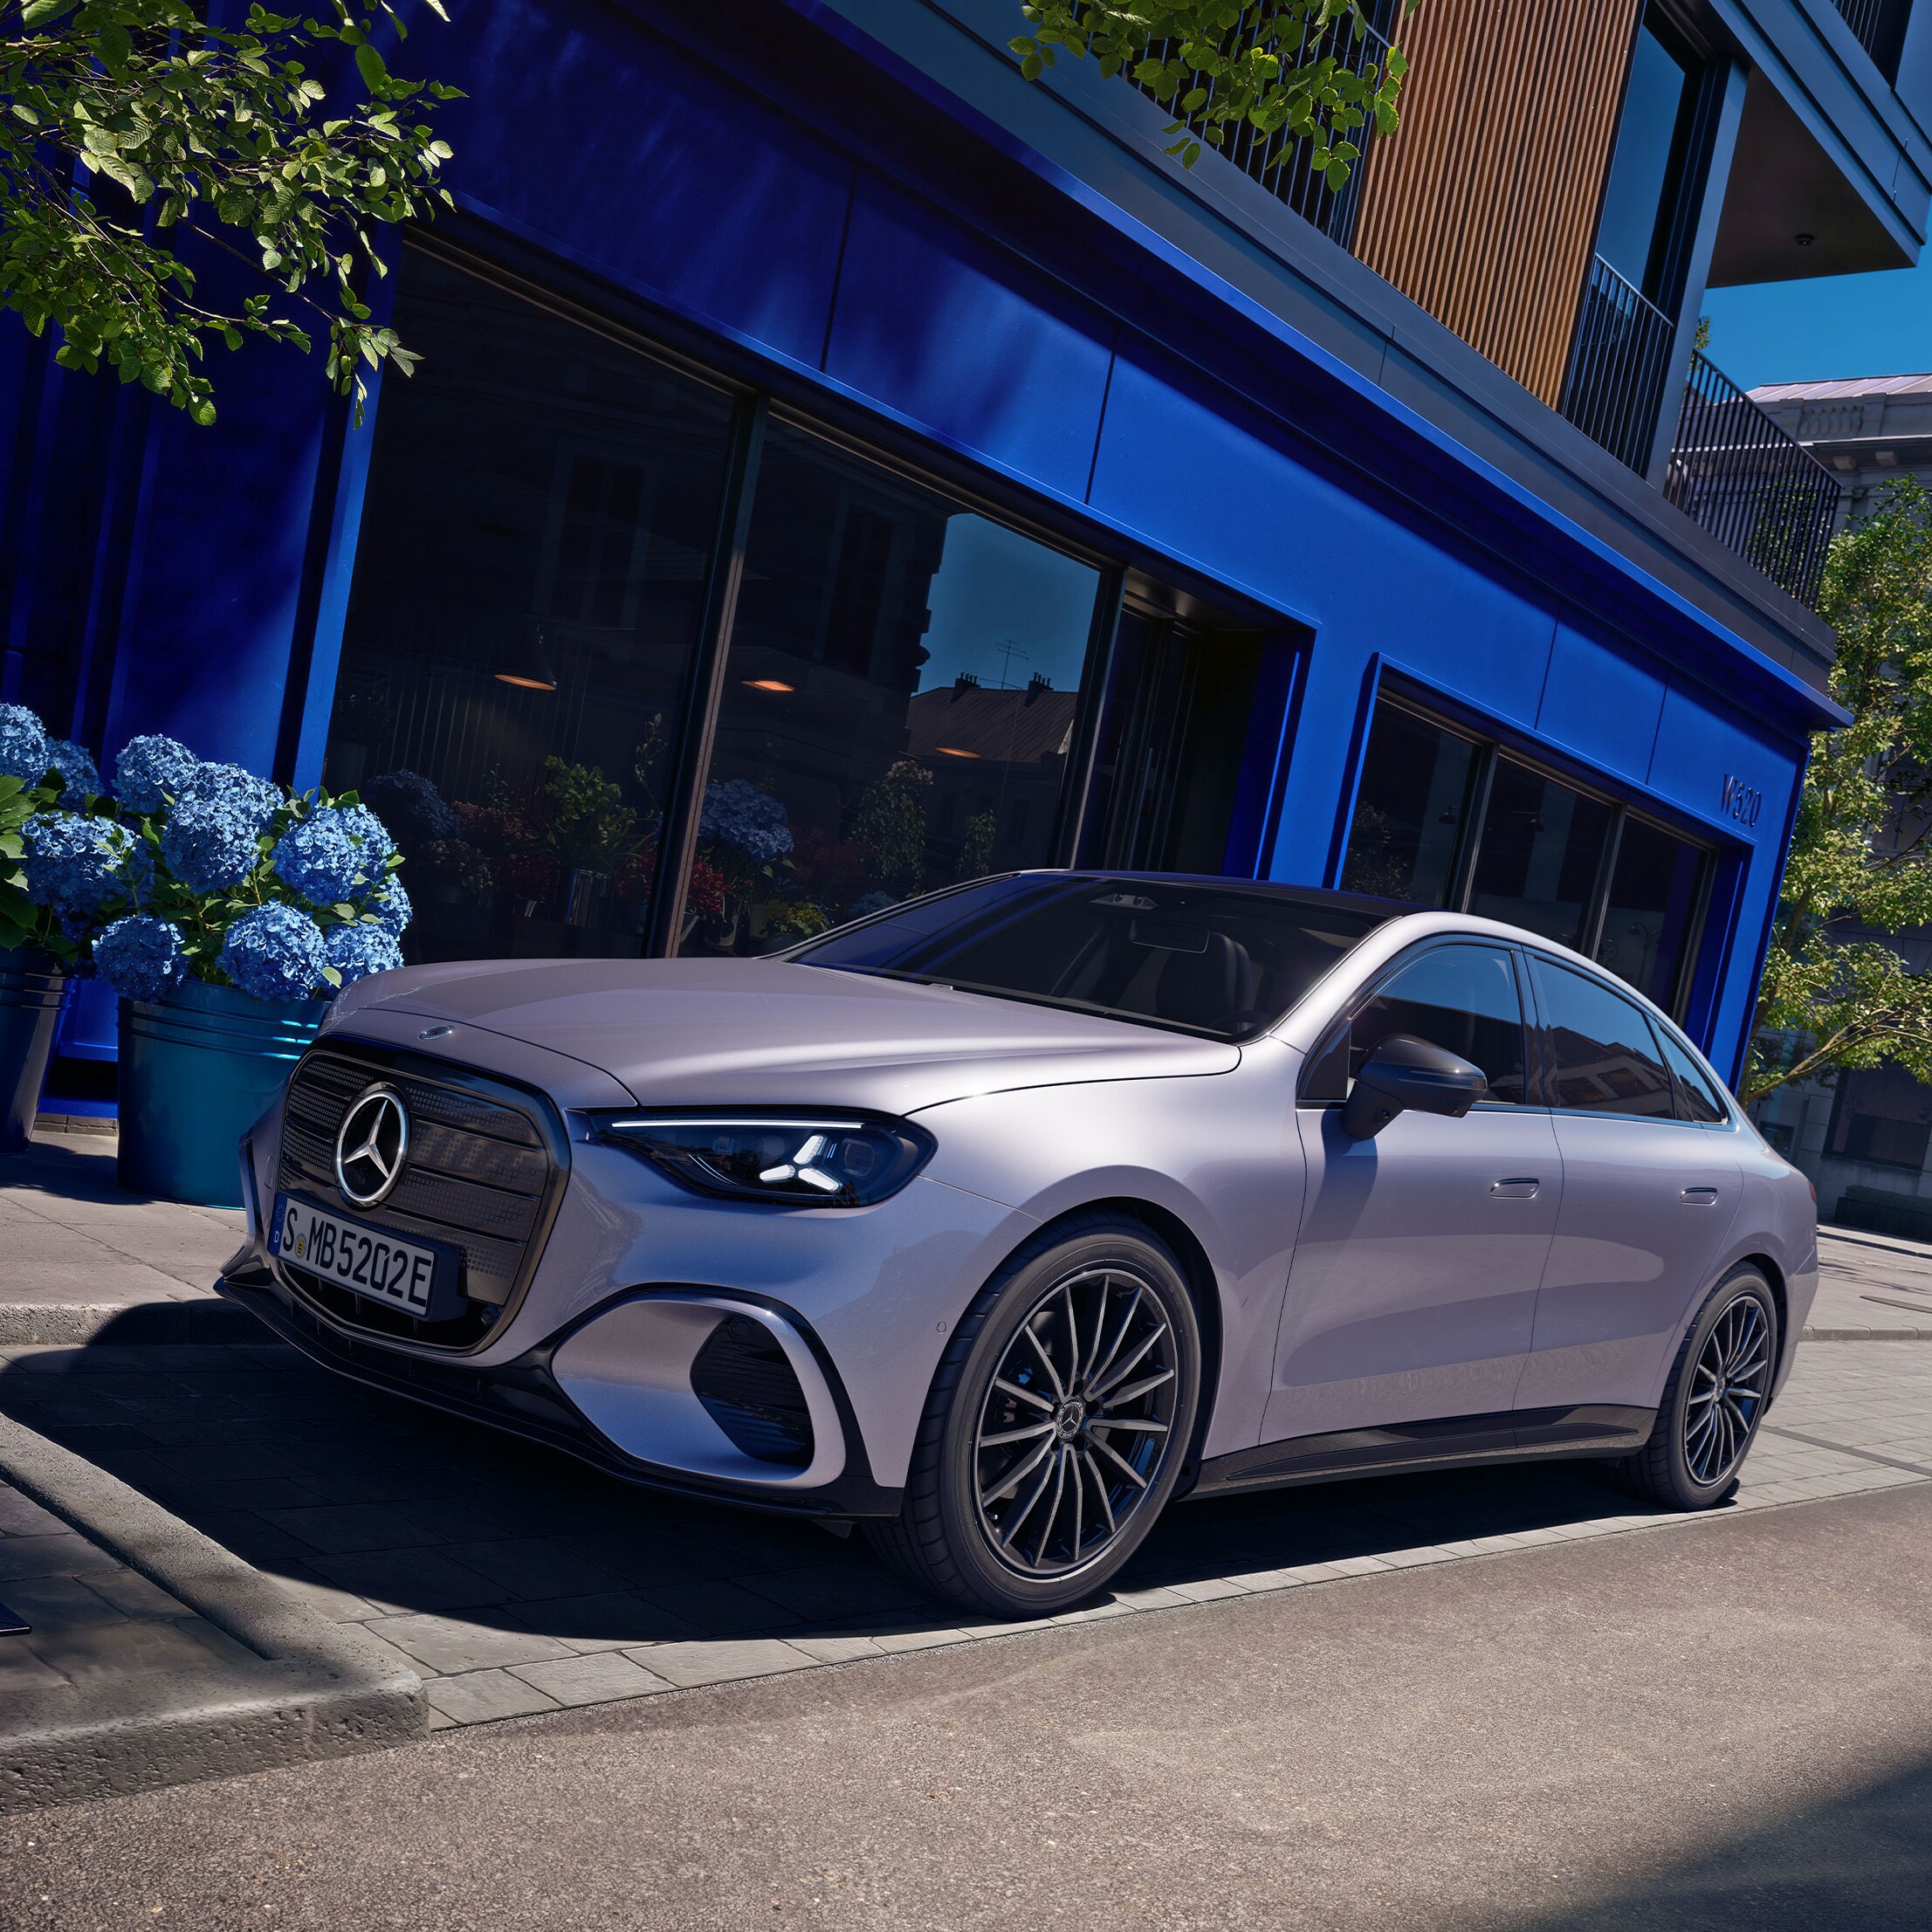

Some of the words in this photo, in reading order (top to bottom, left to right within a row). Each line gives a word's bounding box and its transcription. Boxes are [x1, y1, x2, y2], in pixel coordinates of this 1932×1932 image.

[1721, 773, 1762, 828] W520
[273, 1231, 279, 1243] D
[283, 1208, 298, 1252] S
